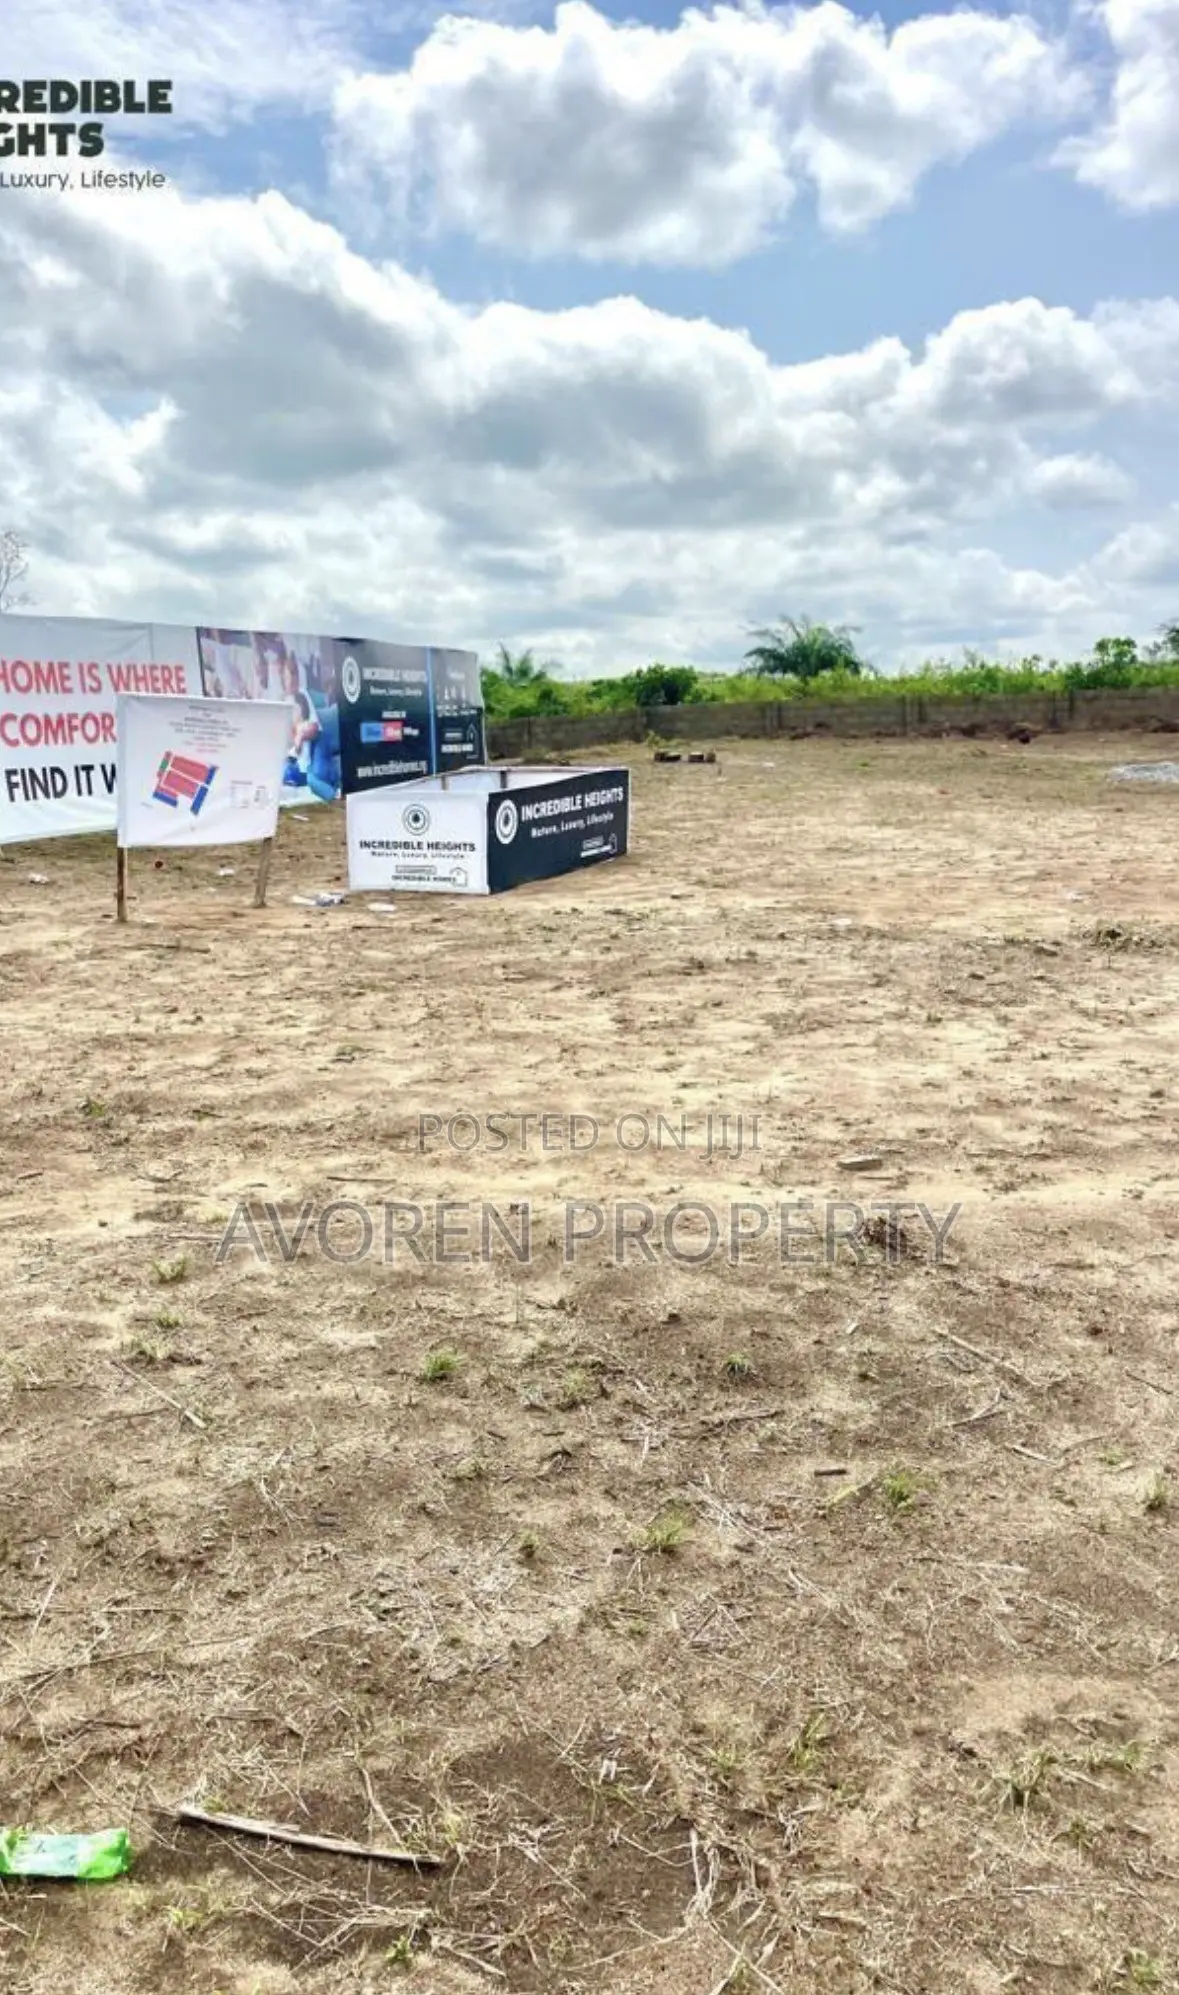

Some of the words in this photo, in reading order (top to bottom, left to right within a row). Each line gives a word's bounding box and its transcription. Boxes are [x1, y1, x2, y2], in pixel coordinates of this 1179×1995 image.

[78, 662, 102, 694] IS
[107, 663, 187, 694] WHERE
[5, 766, 68, 802] FIND
[74, 764, 94, 796] IT
[521, 794, 582, 822] INCREDIBLE
[585, 786, 624, 808] HEIGHTS
[359, 840, 423, 850] INCREDIBLE
[427, 841, 476, 852] HEIGHTS
